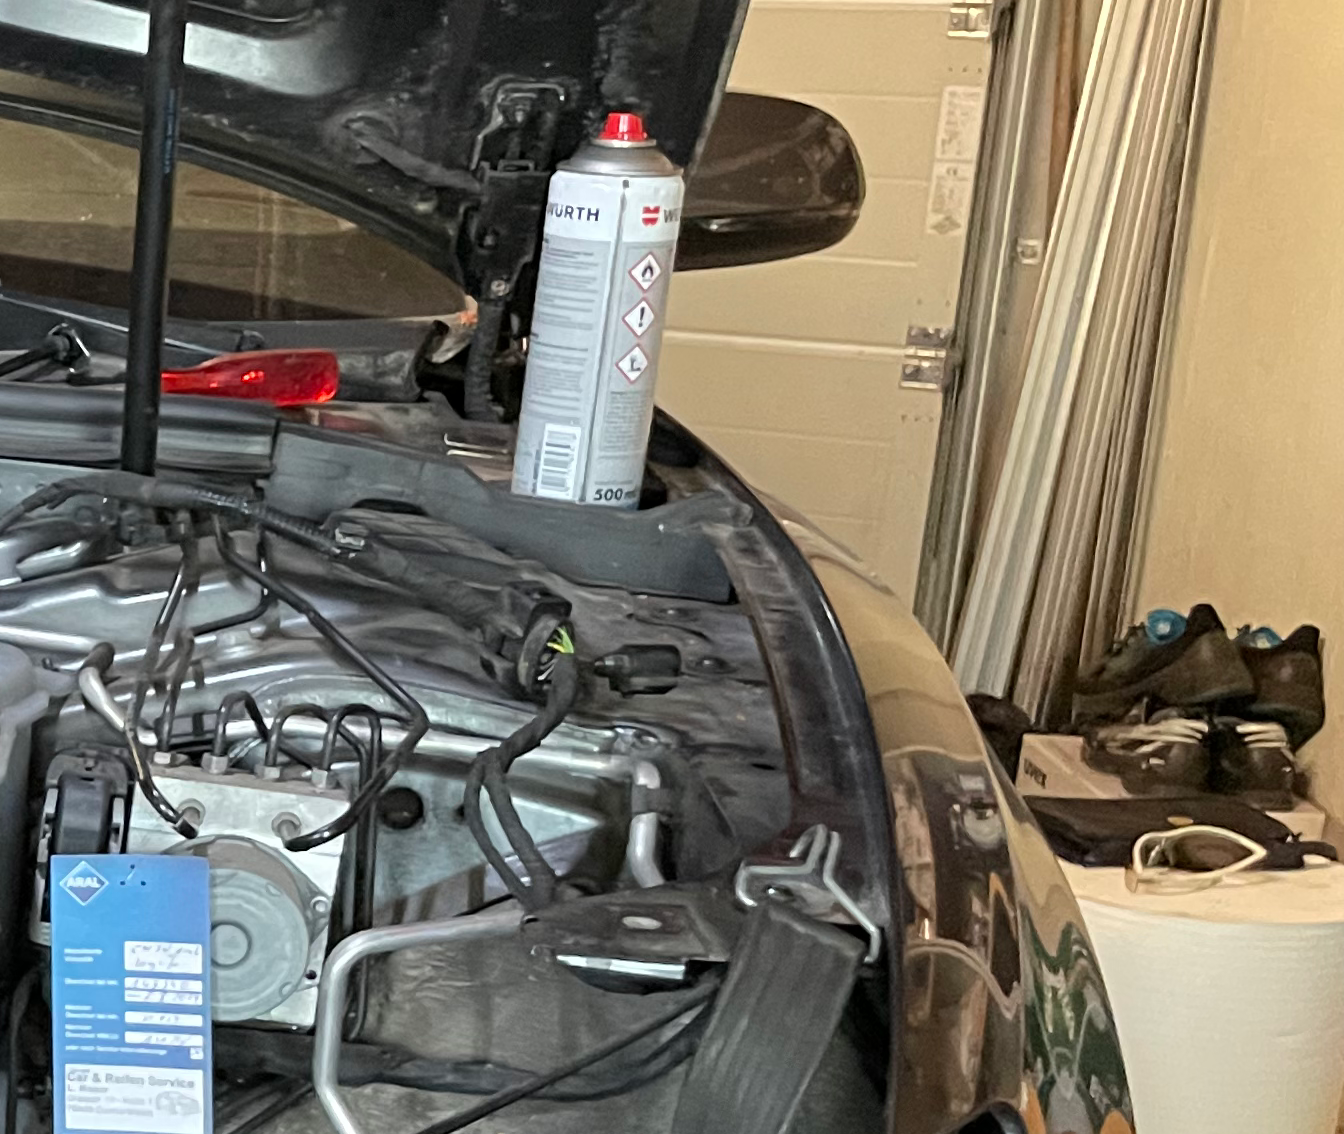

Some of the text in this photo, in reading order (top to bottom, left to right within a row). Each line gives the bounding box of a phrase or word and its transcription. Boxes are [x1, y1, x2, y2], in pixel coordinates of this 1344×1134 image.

[593, 488, 623, 501] 500
[67, 877, 101, 888] ARAL
[67, 1071, 89, 1082] Car
[92, 1073, 101, 1083] &
[148, 1076, 195, 1088] Service
